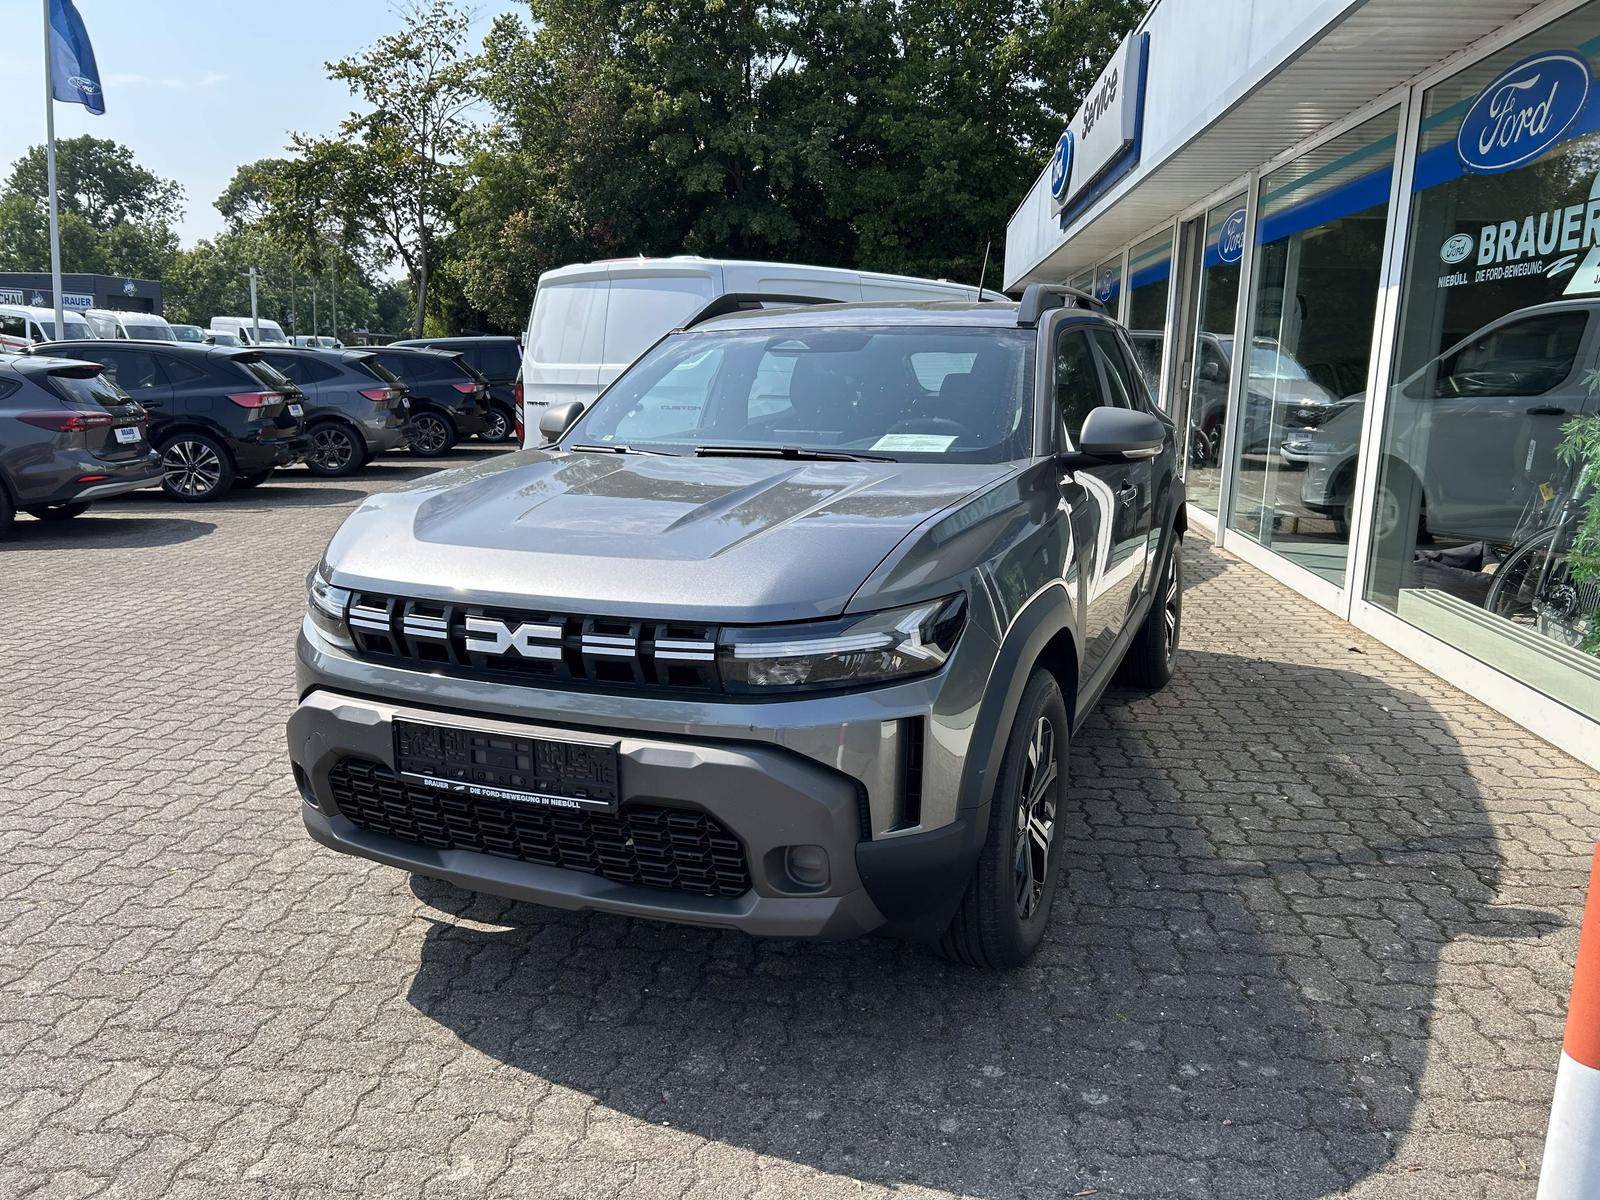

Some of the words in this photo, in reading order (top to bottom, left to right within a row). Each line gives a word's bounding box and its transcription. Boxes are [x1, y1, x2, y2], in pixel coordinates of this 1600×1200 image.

[1082, 67, 1118, 140] Service
[1478, 73, 1559, 155] Ford
[1477, 200, 1600, 266] BRAUER
[1446, 239, 1467, 258] Ford
[1438, 271, 1468, 288] NIEBÜLL
[1475, 270, 1485, 283] DIE
[1486, 260, 1543, 281] FORD-BEWEGUNG
[423, 778, 449, 789] BRAUER
[469, 787, 481, 795] DIE
[482, 789, 541, 804] FORD-BEWEGUNG
[550, 797, 581, 809] NIEBÜLL
